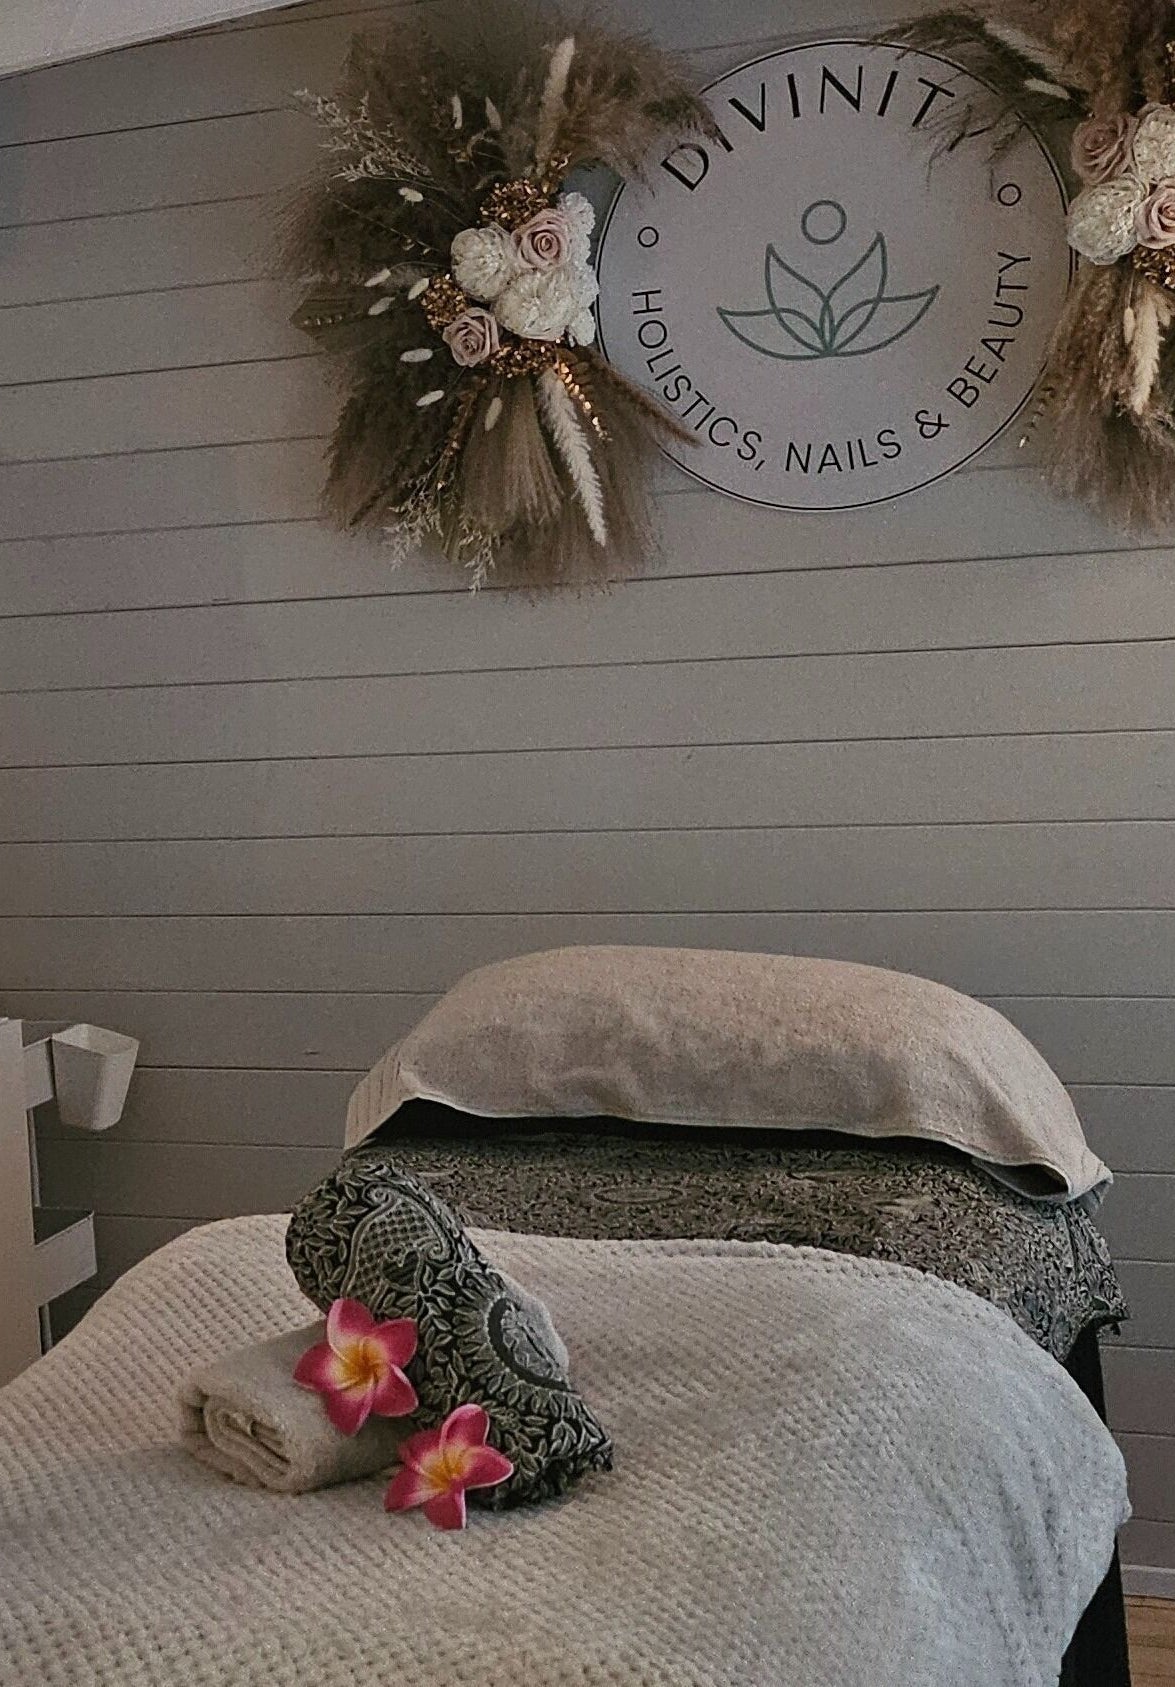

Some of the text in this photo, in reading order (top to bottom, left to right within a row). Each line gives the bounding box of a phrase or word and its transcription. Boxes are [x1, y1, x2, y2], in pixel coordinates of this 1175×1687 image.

[632, 251, 1031, 474] HOLISTICS, NAILS & BEAUTY
